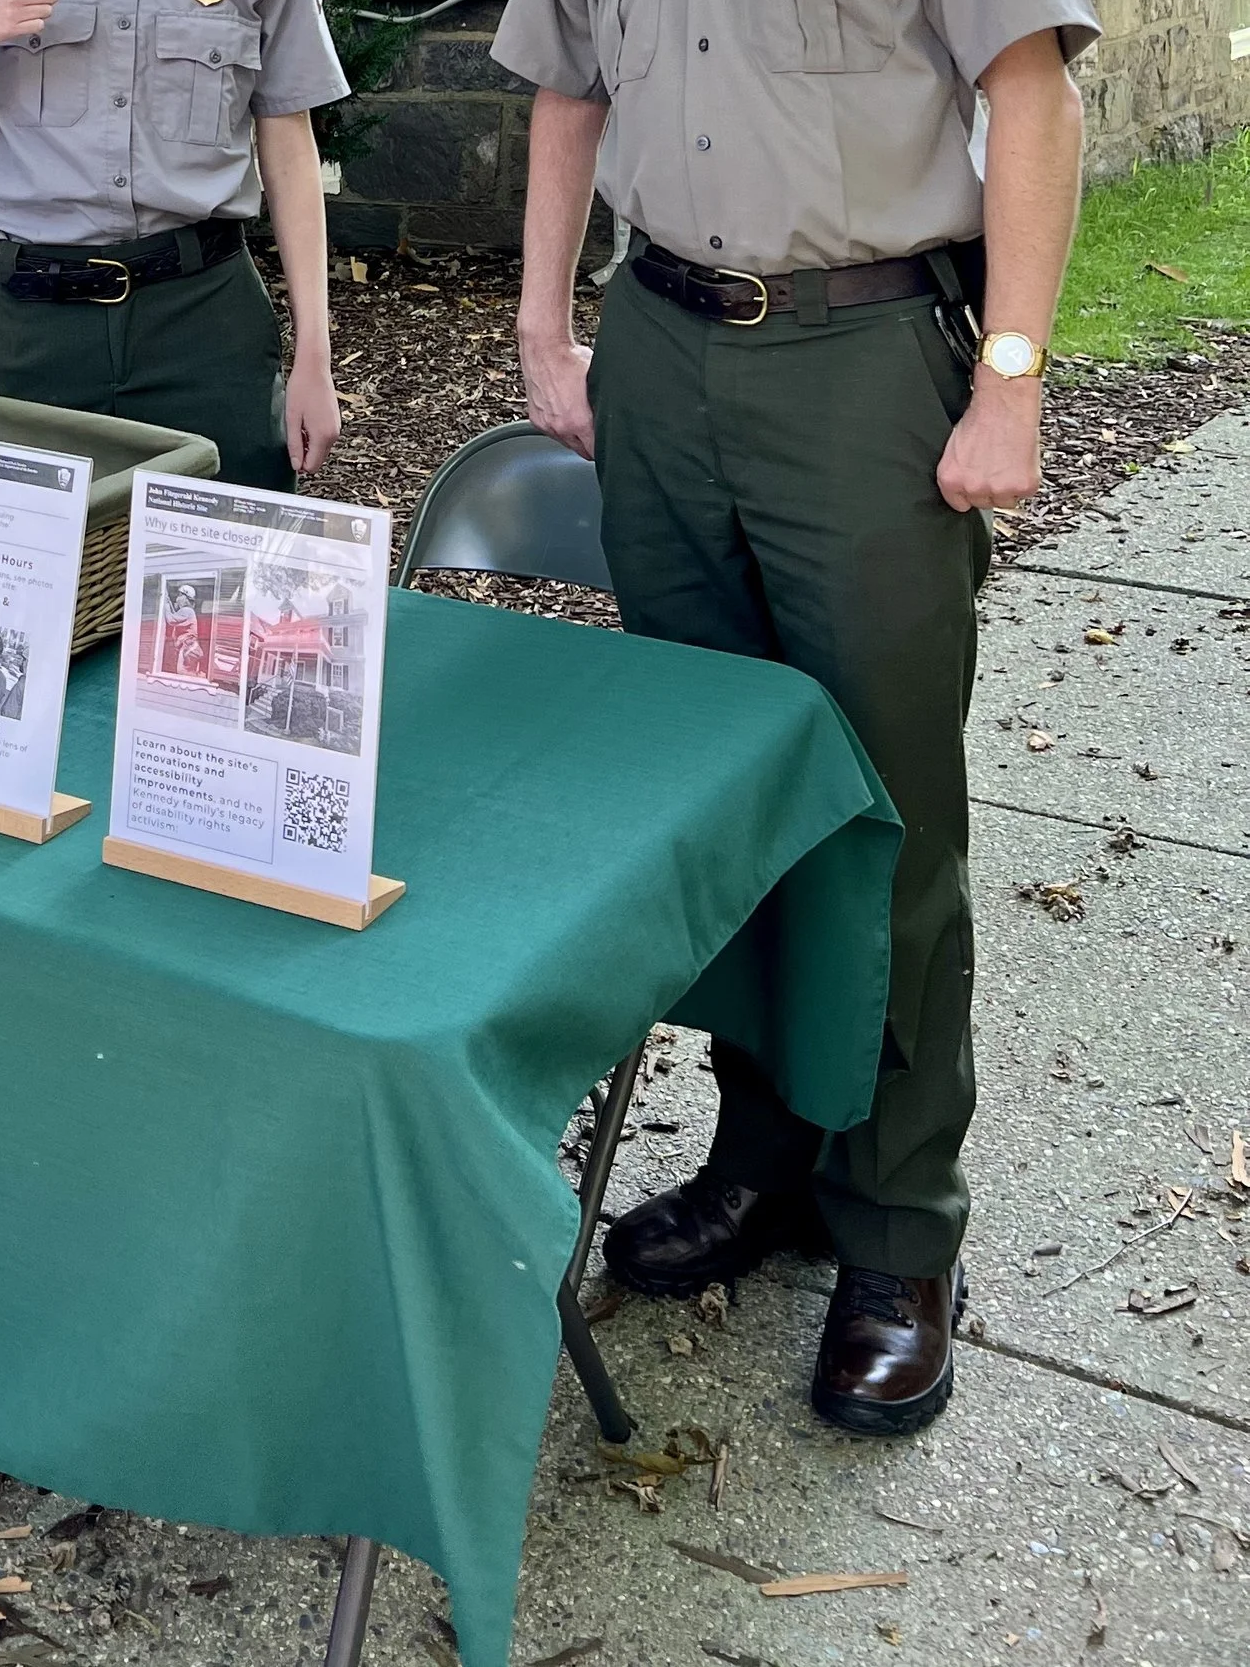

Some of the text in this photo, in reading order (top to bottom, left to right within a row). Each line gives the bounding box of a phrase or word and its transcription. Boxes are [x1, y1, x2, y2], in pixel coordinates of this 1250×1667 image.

[147, 495, 208, 512] National Historic Site
[148, 486, 219, 506] John Fitzgerald Kennedy
[144, 515, 264, 547] Why is the site closed?
[1, 554, 33, 569] Hours
[28, 577, 53, 589] photos
[2, 596, 10, 606] &
[19, 744, 28, 753] of
[136, 736, 258, 773] Learn about the site's
[135, 748, 225, 778] renovations and
[134, 761, 203, 788] accessibility
[132, 786, 265, 830] Kennedy family's legacy
[219, 795, 240, 809] and
[243, 800, 263, 814] the
[131, 799, 231, 834] of disability rights
